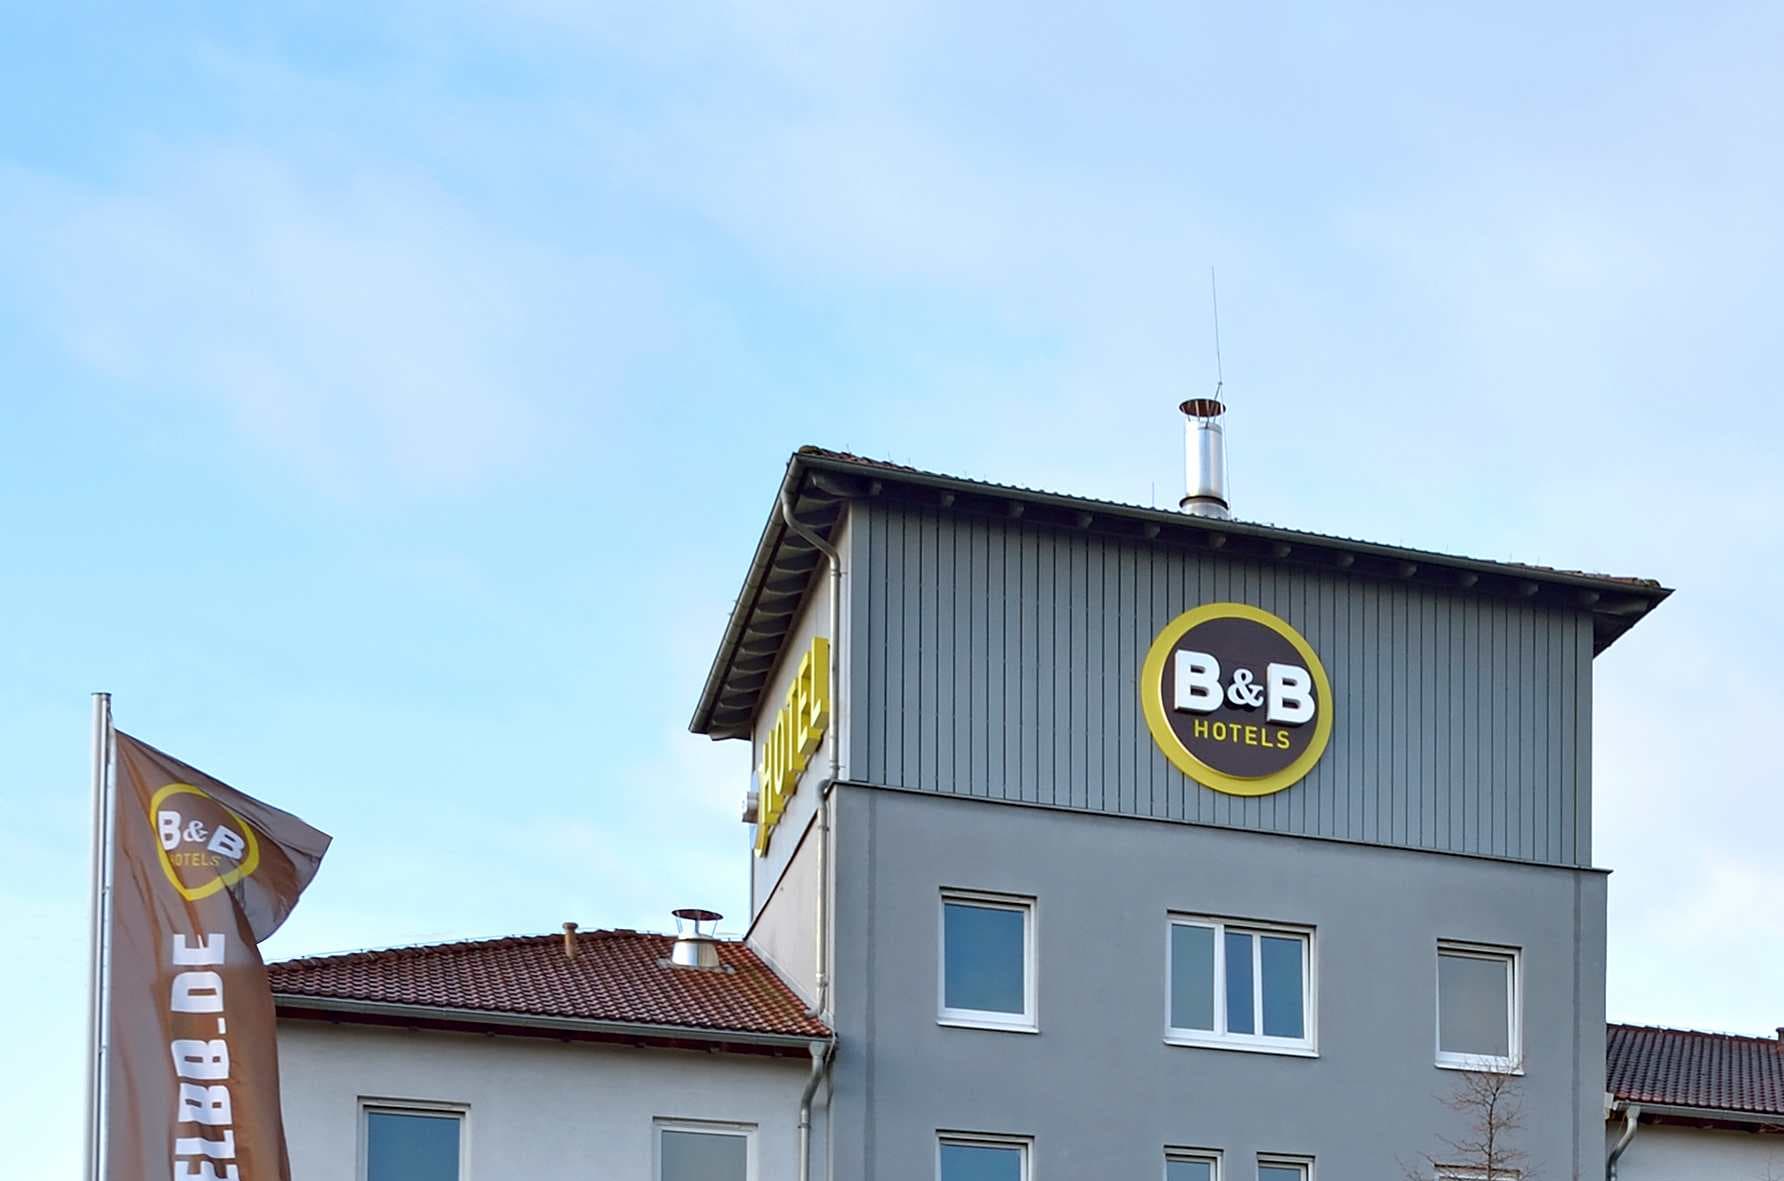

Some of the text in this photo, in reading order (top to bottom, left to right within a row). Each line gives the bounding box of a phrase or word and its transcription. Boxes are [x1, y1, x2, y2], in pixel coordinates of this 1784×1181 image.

[1174, 650, 1316, 724] B&B
[1194, 720, 1291, 749] HOTELS
[158, 810, 246, 860] B&B
[171, 852, 221, 867] OTELS
